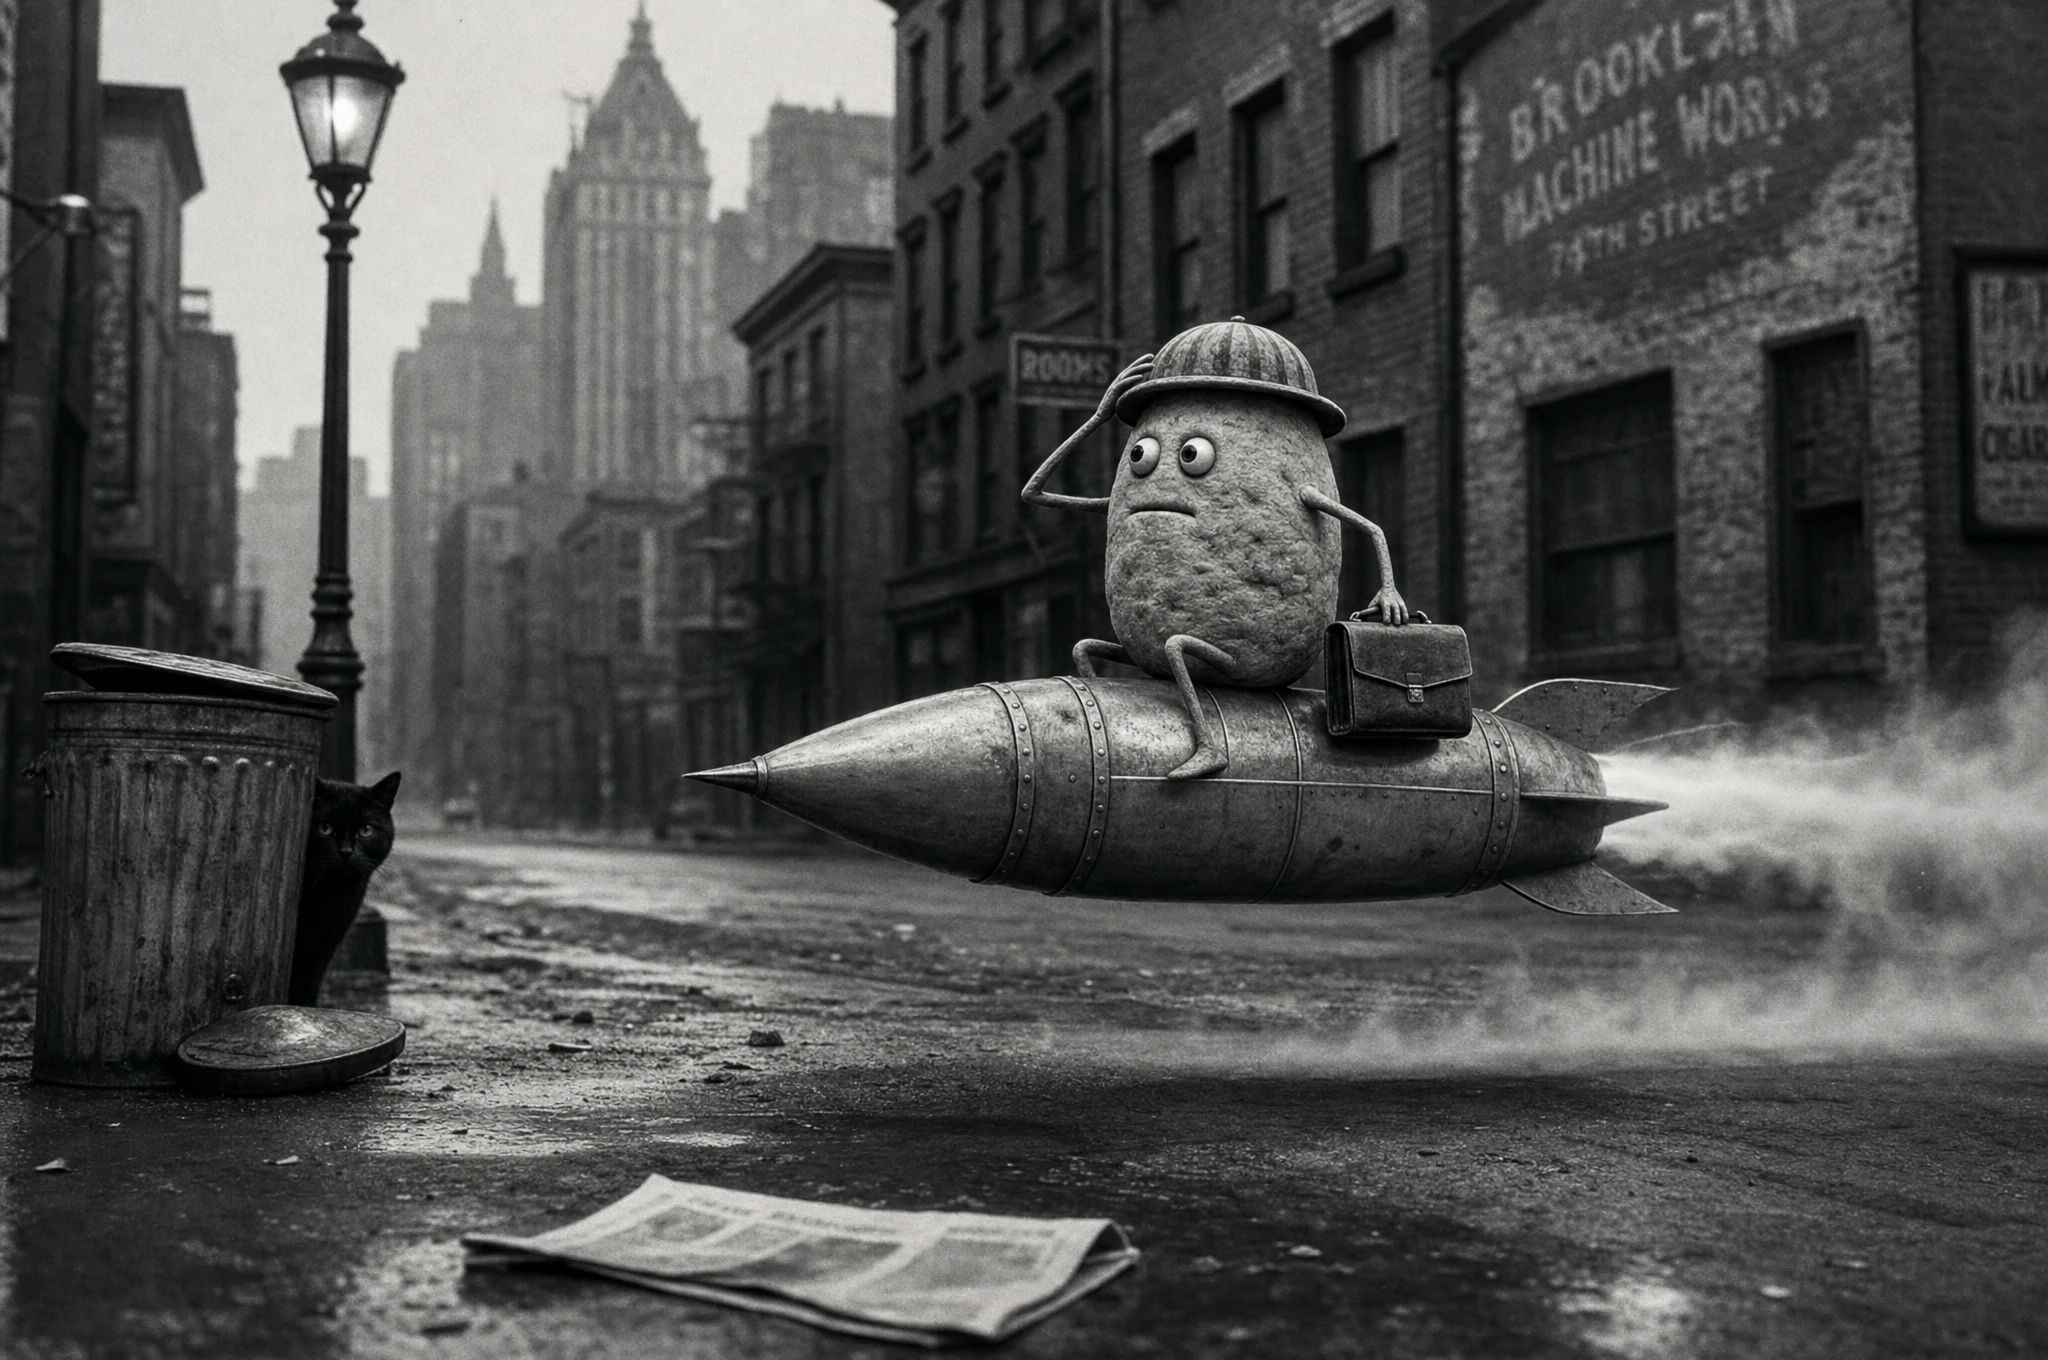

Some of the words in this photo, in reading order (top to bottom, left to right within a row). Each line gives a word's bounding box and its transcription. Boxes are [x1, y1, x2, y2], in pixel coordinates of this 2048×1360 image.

[1501, 108, 1660, 246] MACHINE
[1637, 165, 1776, 247] STREET
[1021, 348, 1112, 385] ROOMS
